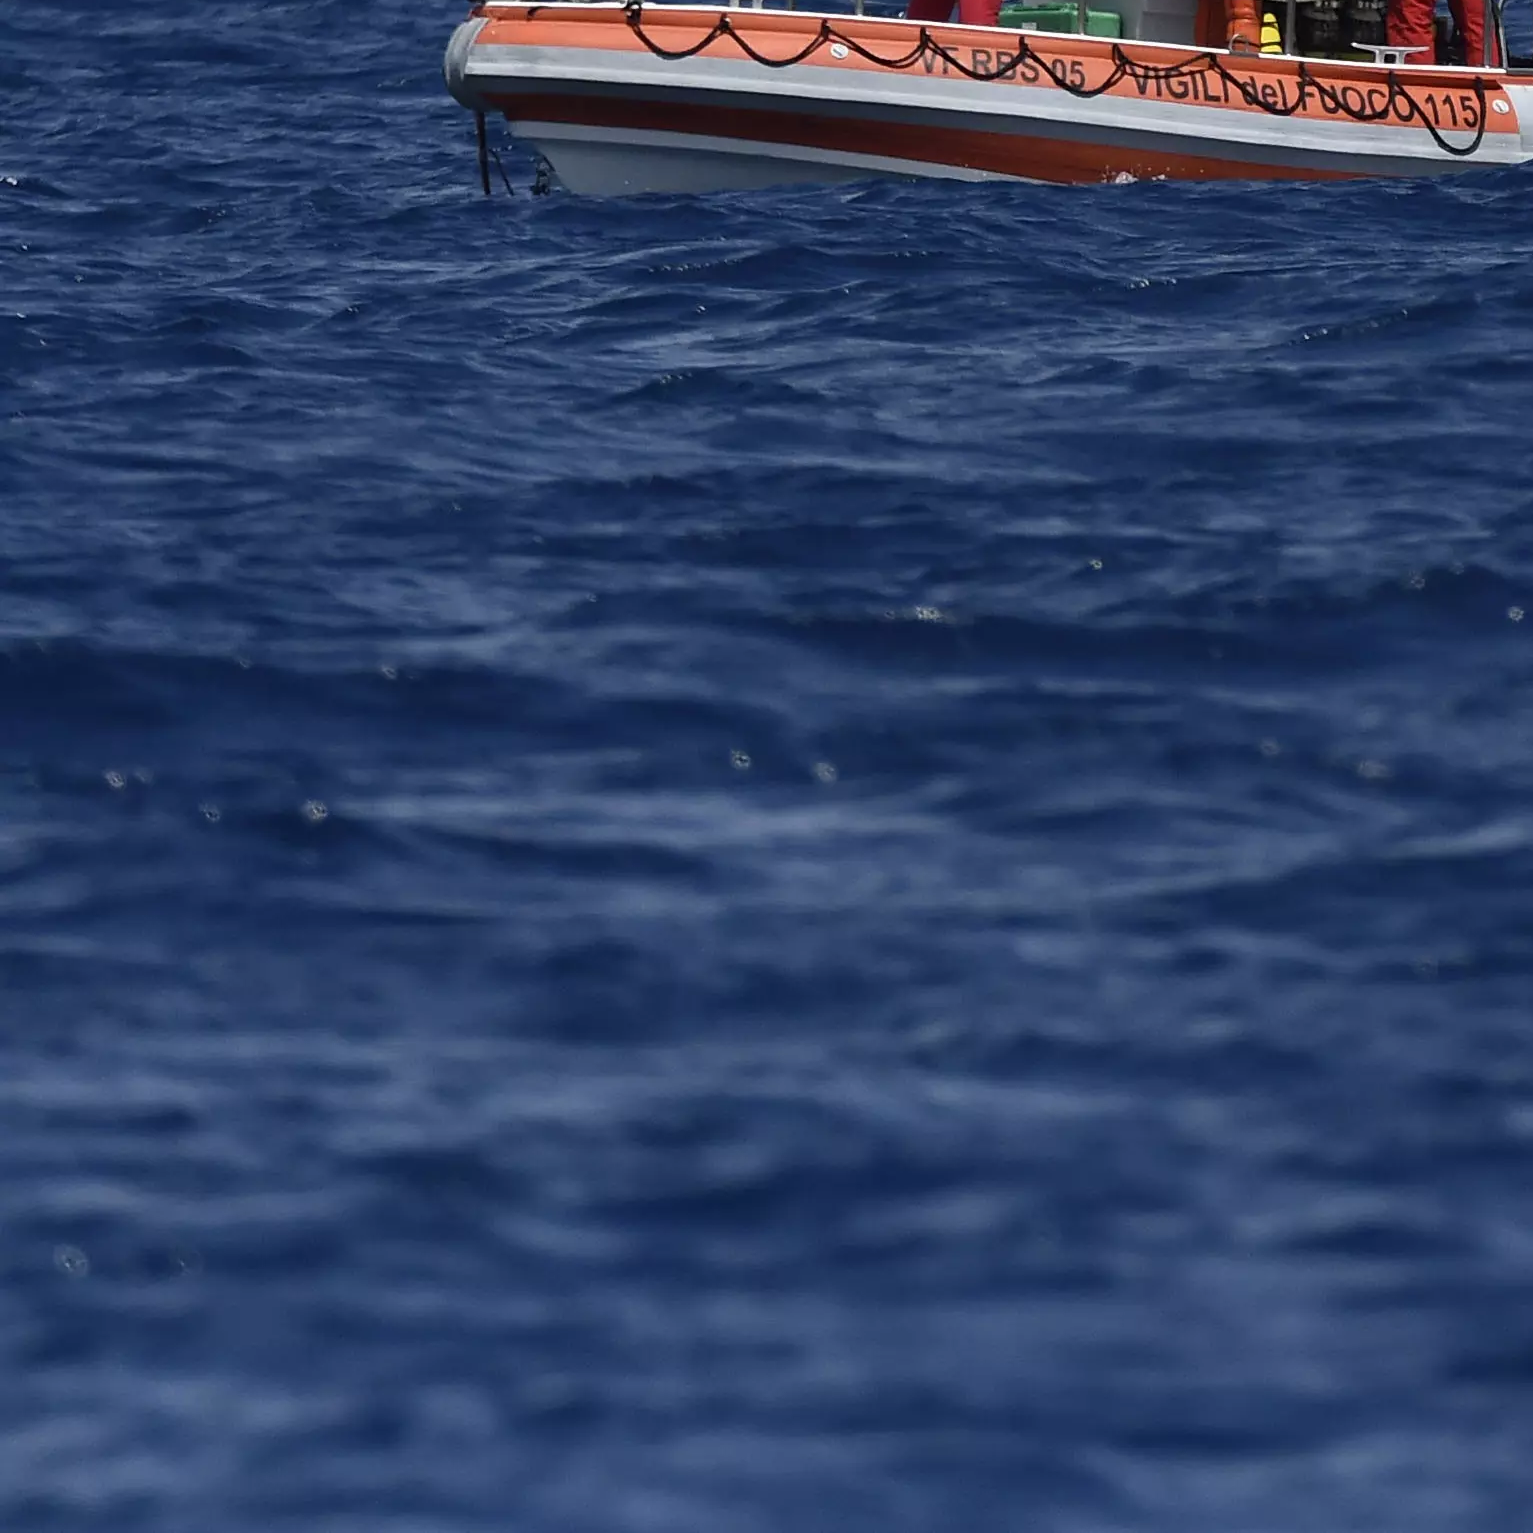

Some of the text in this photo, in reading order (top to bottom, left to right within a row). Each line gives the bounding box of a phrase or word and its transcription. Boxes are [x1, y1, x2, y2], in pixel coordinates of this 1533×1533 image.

[971, 48, 1041, 84] RBS
[1050, 58, 1087, 92] 05
[1130, 64, 1230, 104] VIGILI
[1425, 93, 1479, 128] 115
